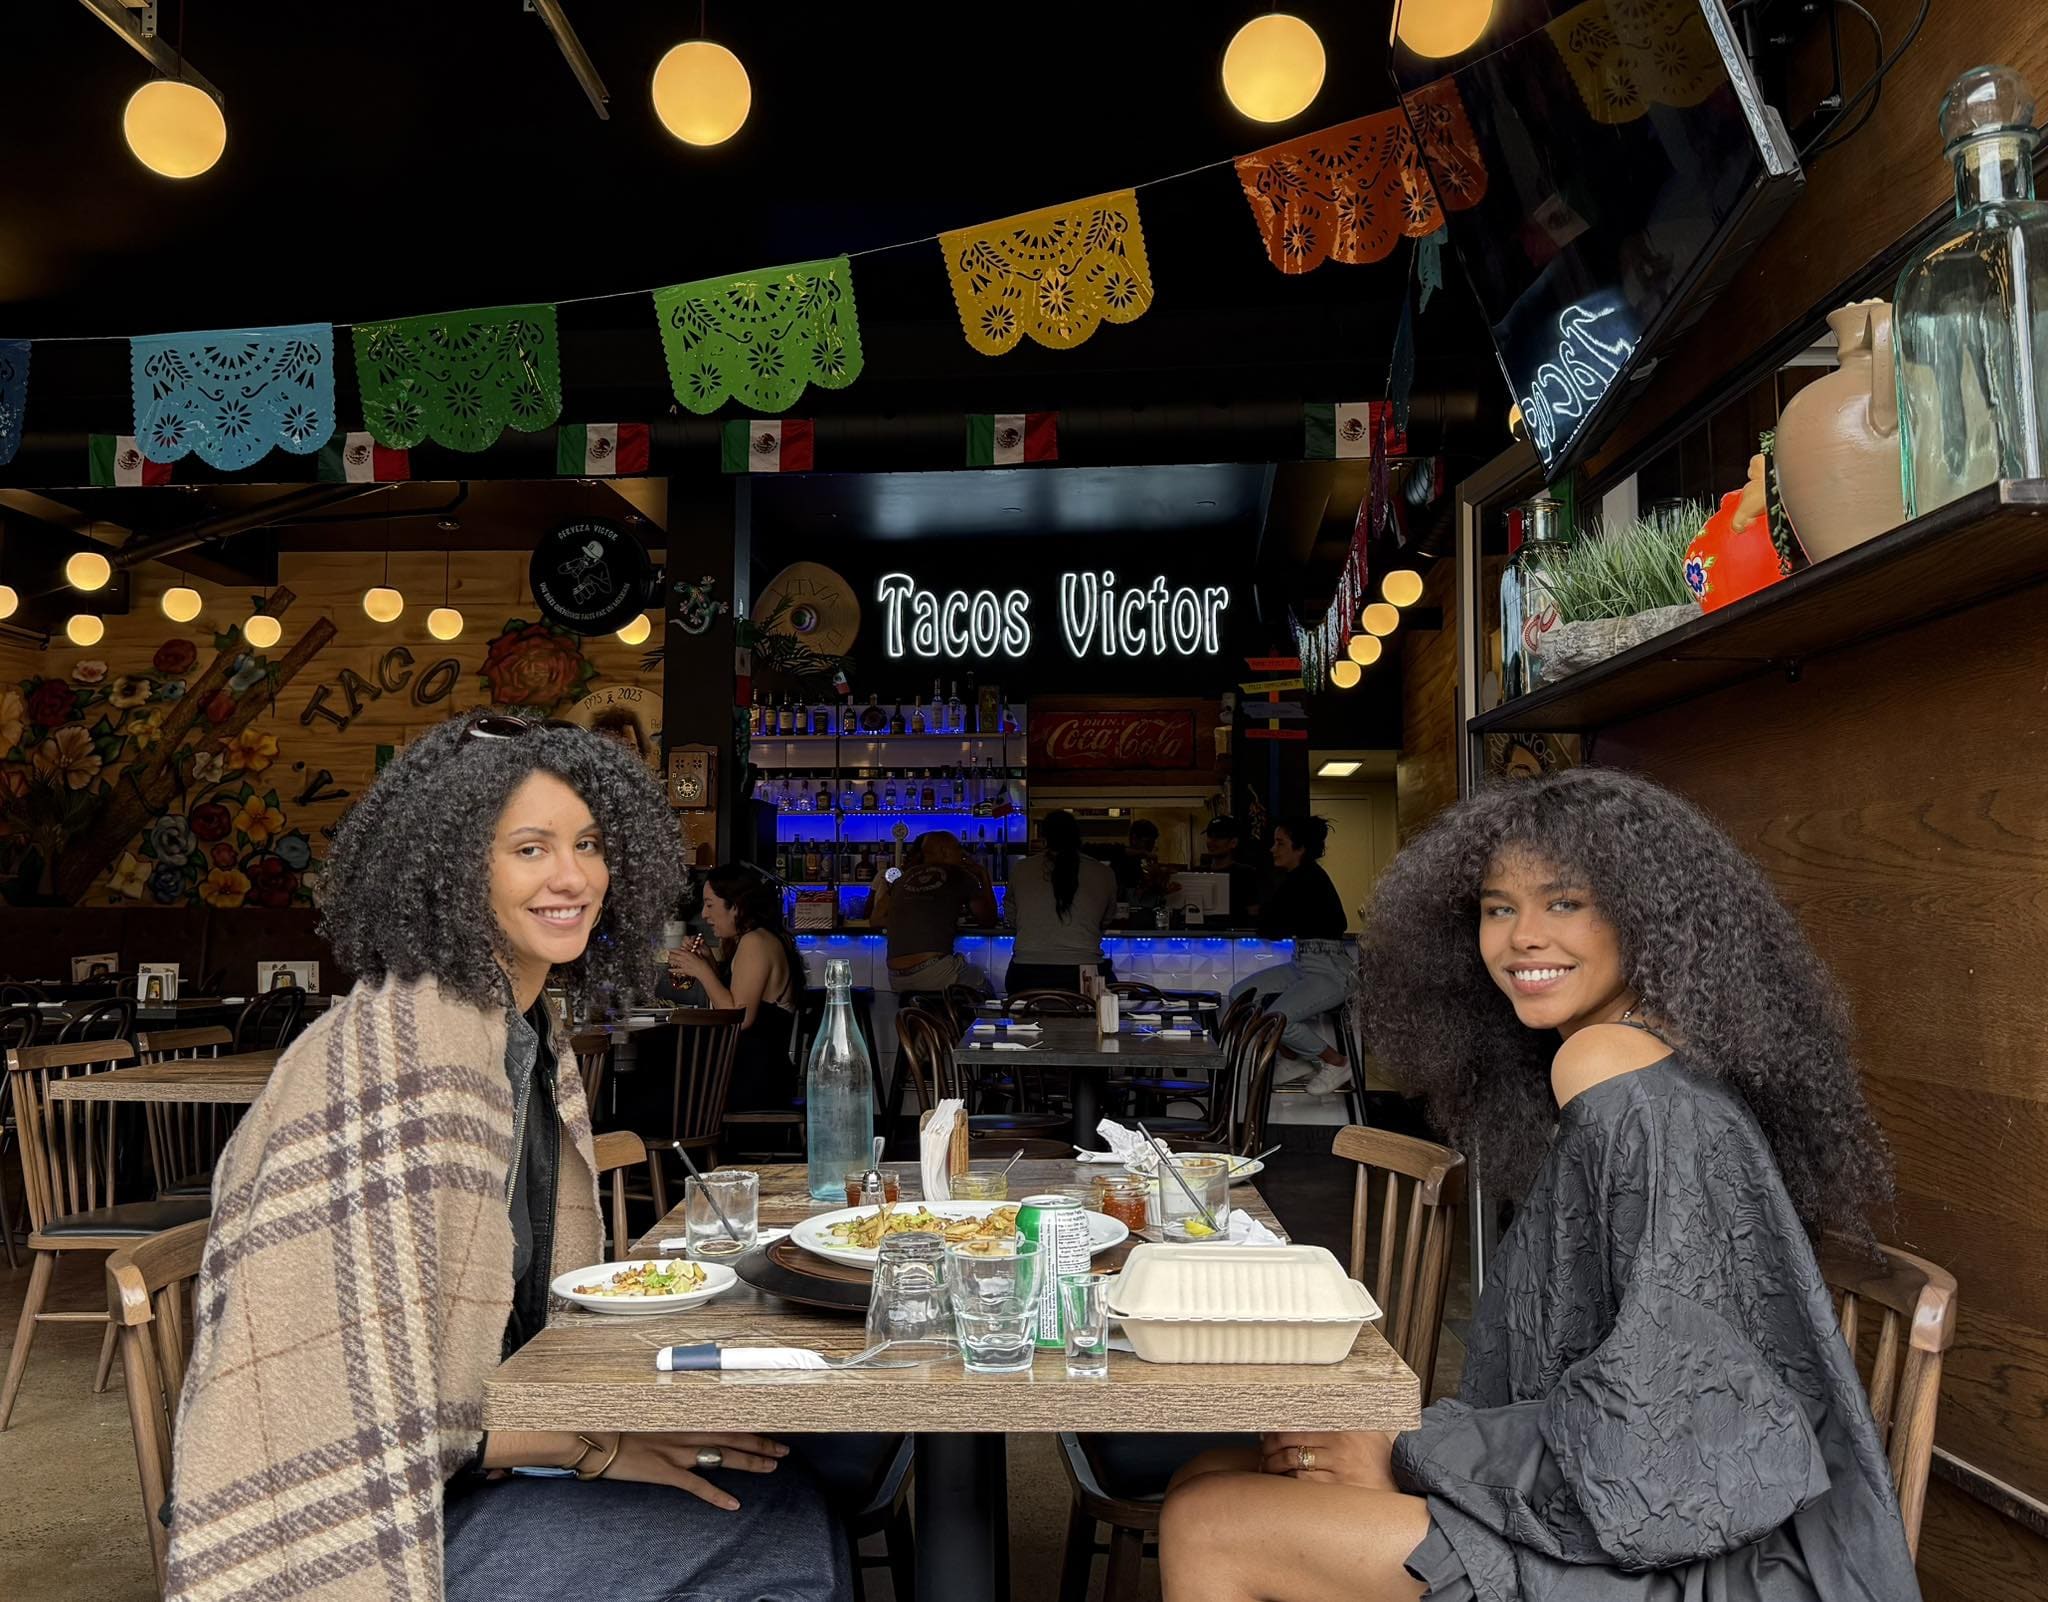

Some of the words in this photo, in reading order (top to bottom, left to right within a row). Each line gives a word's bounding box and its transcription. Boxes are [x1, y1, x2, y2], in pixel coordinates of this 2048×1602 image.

[558, 524, 590, 540] CERVEZA
[594, 525, 619, 541] VICTOR
[878, 573, 1031, 657] Tacos
[1061, 571, 1229, 657] Victor
[301, 646, 460, 732] TACO
[617, 688, 643, 702] 2023
